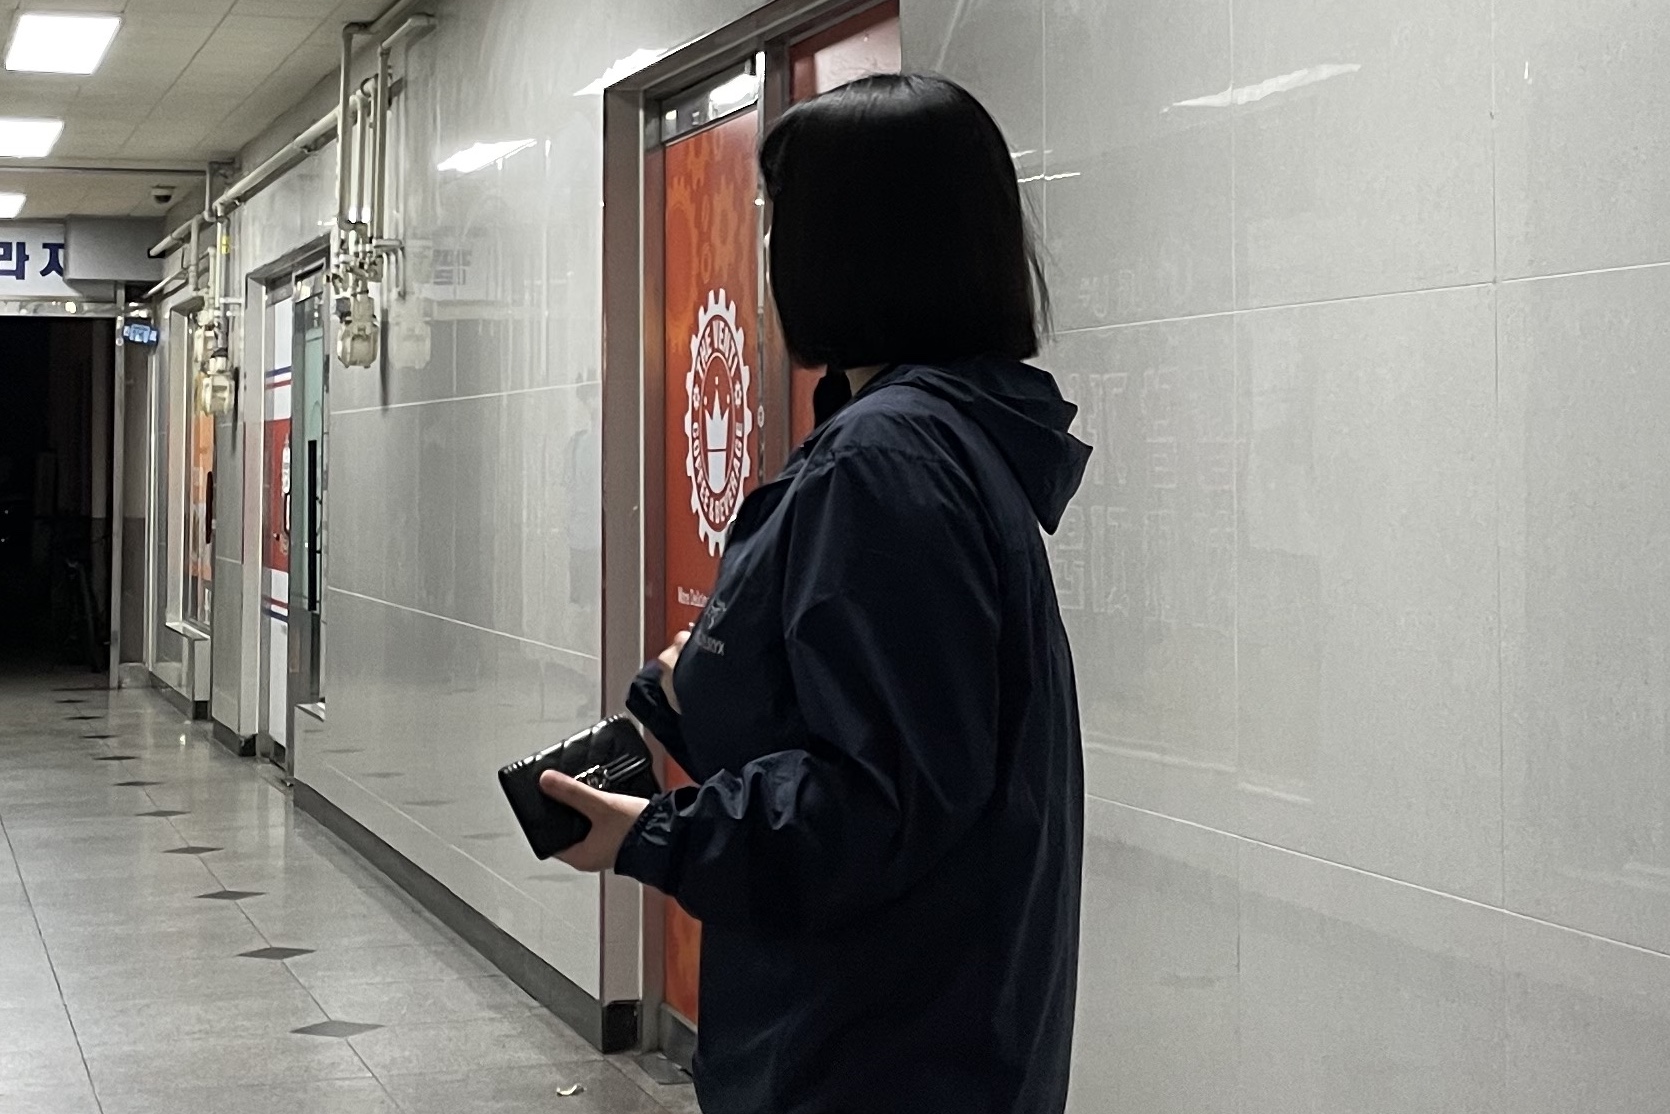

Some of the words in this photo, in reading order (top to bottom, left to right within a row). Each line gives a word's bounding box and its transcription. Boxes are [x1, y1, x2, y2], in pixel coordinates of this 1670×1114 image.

[696, 325, 712, 379] THE
[712, 319, 738, 378] VENTI
[692, 421, 710, 512] COFFEE
